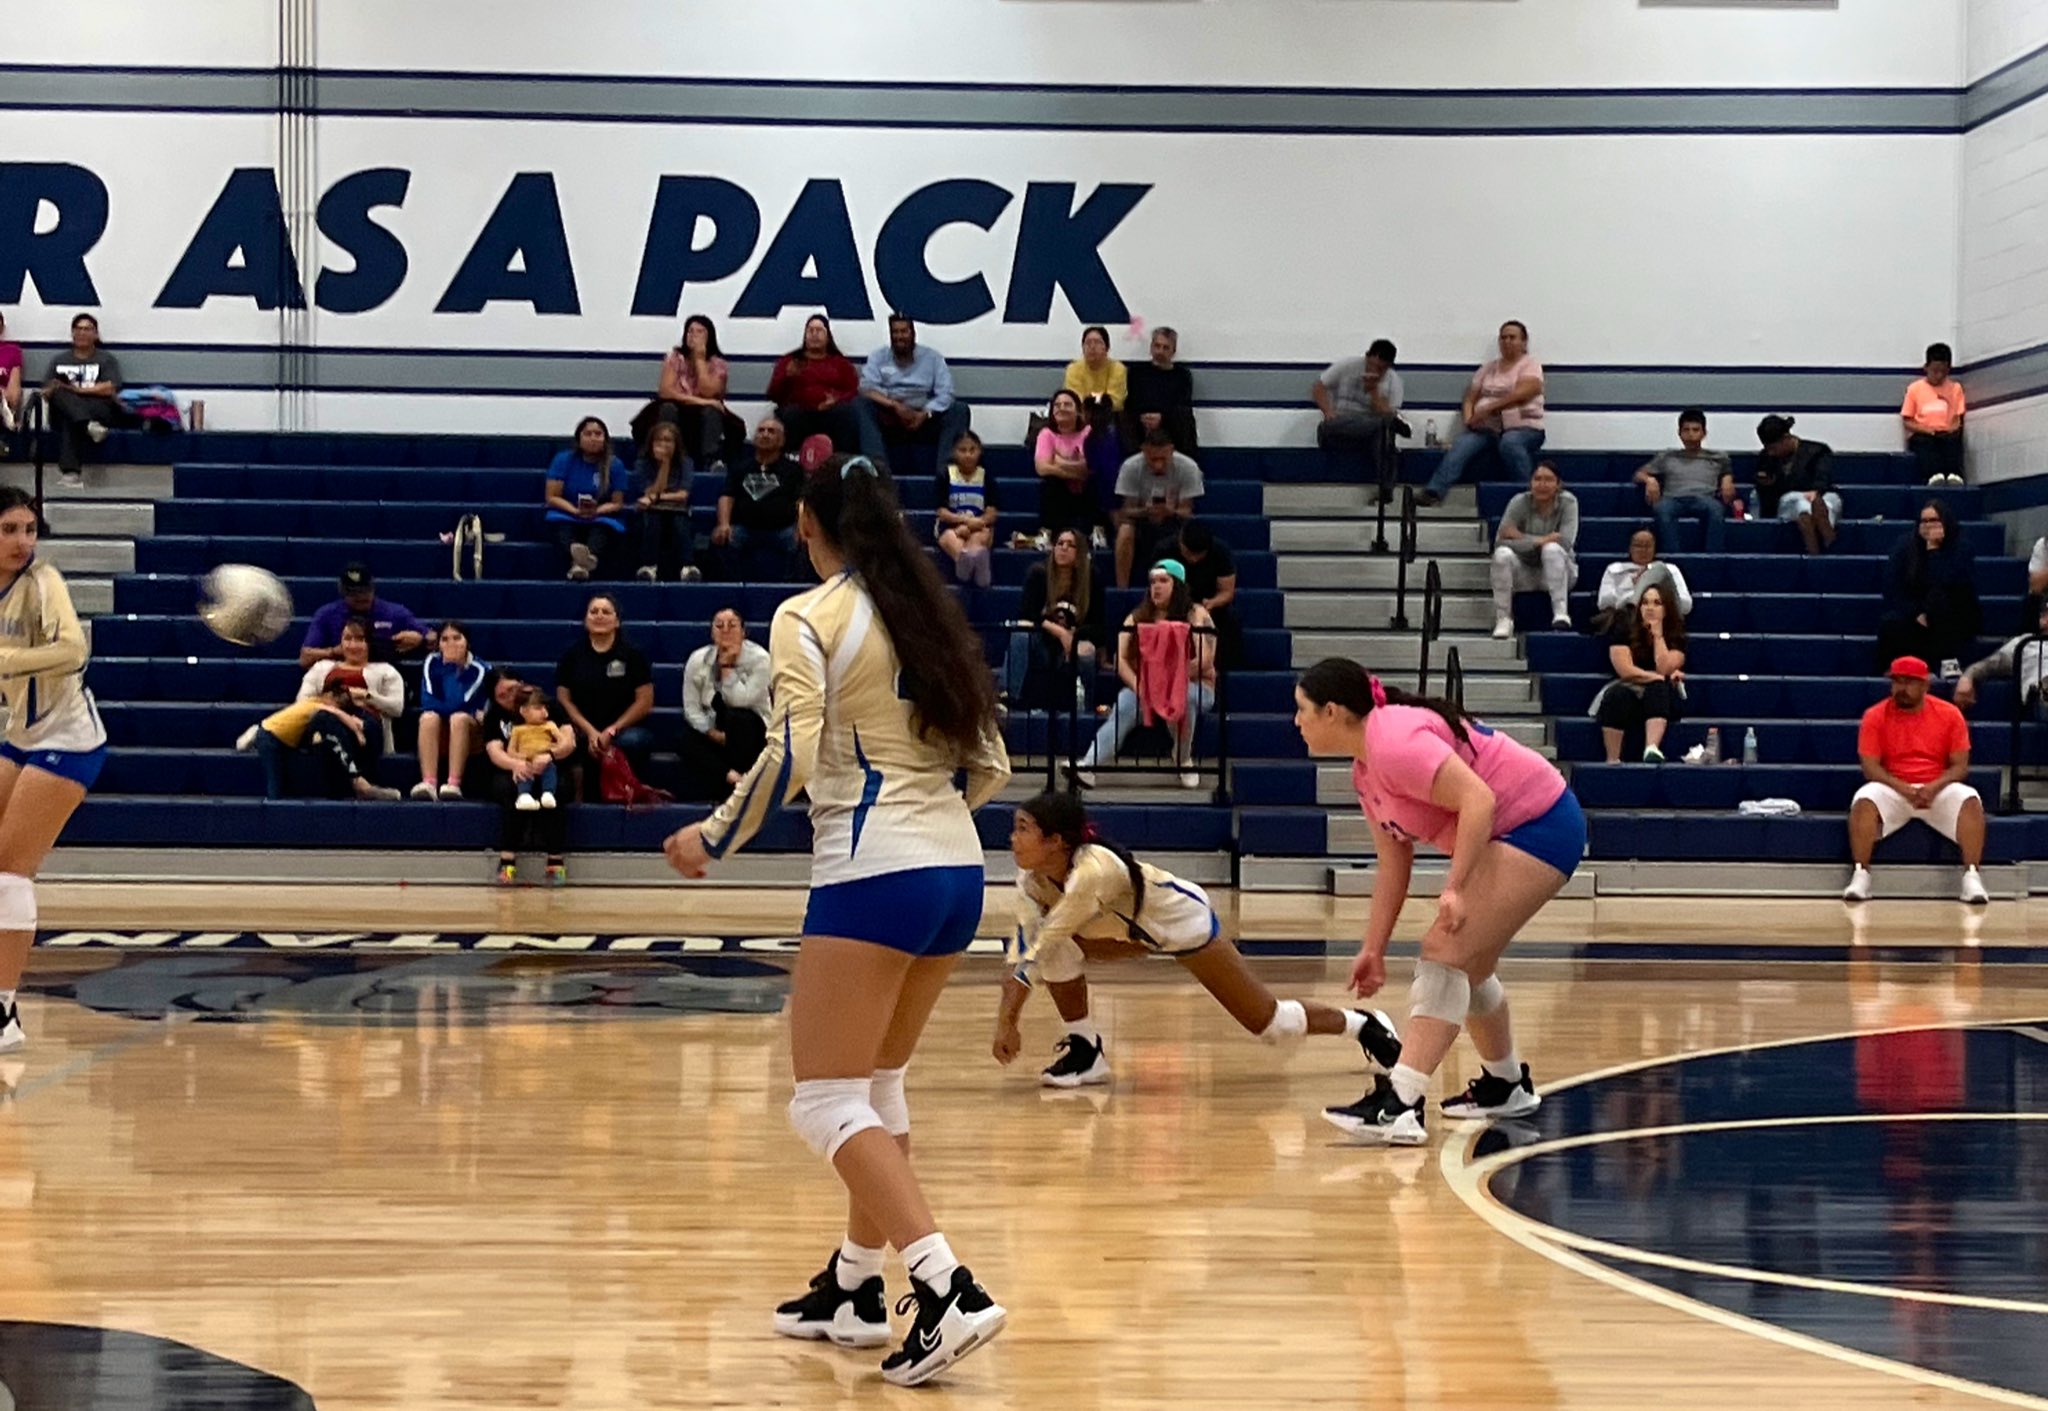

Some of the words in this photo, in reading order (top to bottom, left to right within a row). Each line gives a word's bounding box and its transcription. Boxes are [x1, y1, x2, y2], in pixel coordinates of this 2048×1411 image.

[152, 167, 411, 315] AS
[434, 172, 582, 316] A
[630, 174, 1155, 326] PACK
